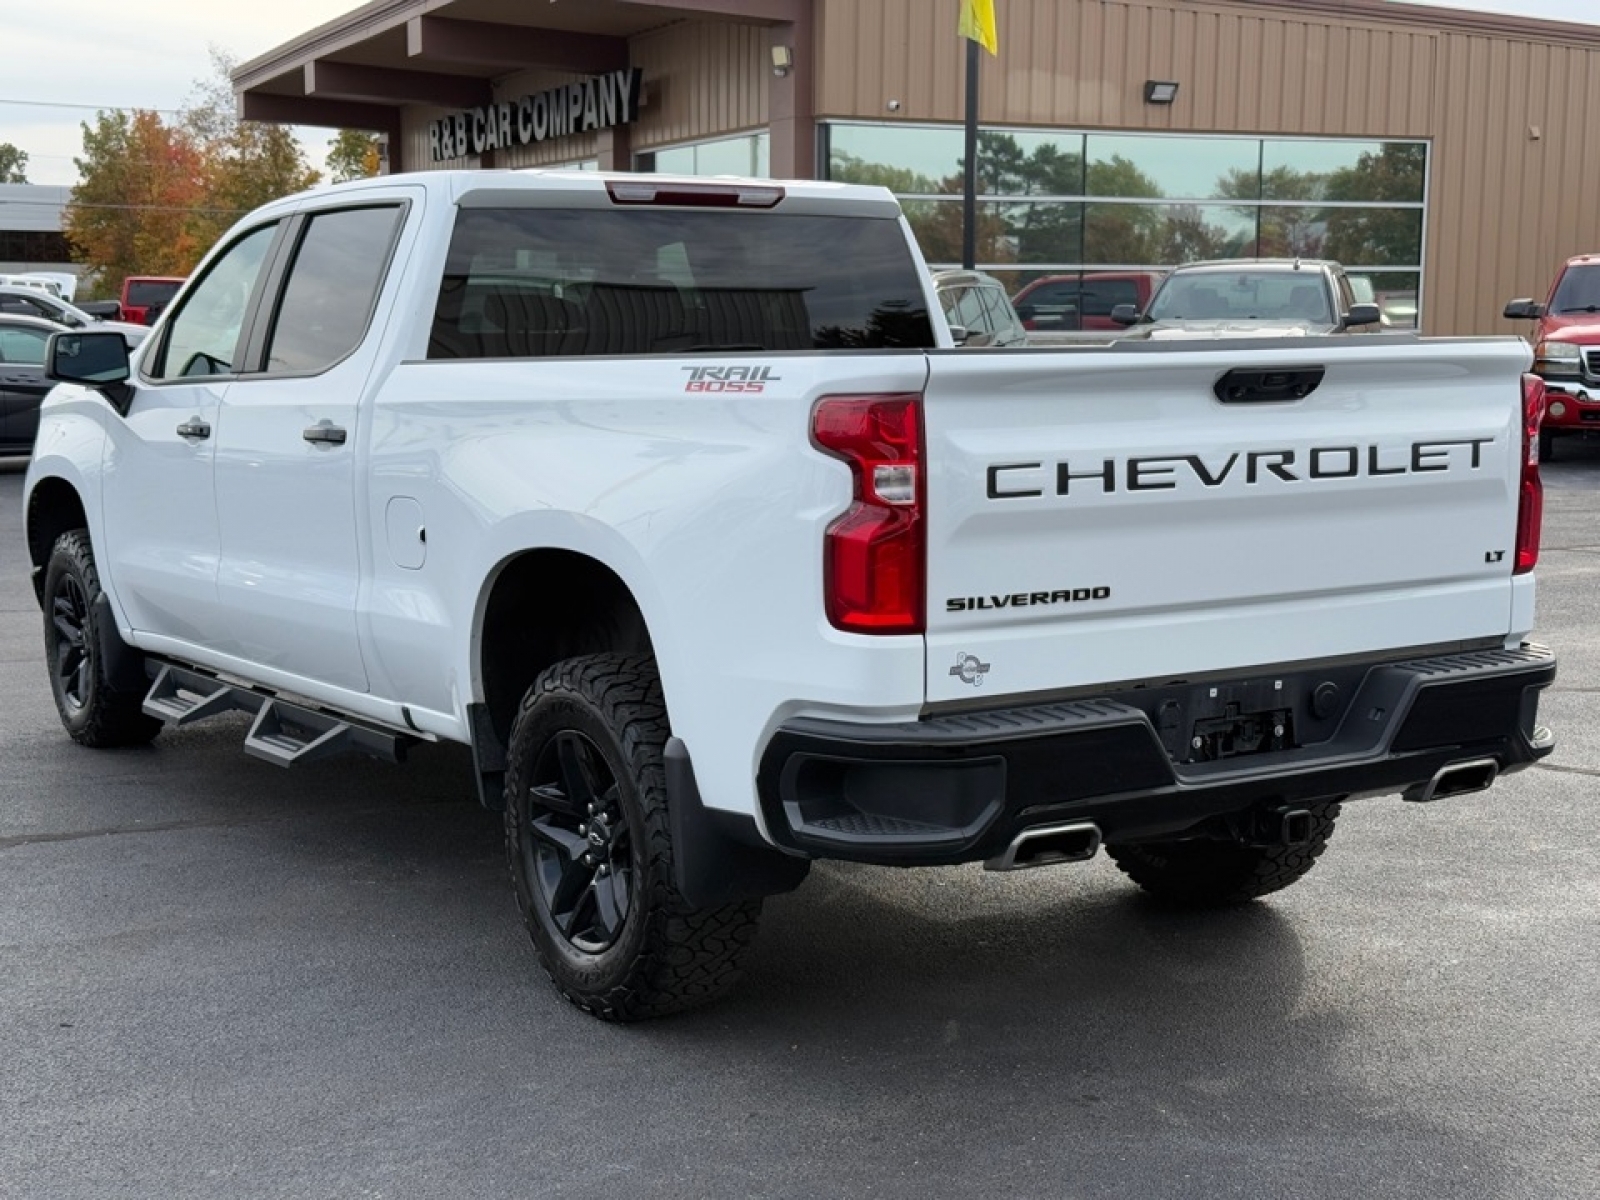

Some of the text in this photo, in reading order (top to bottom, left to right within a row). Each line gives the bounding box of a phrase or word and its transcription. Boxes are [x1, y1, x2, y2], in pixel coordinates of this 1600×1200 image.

[429, 67, 640, 161] R&B CAR COMPANY
[681, 366, 782, 381] TRAIL
[685, 381, 765, 393] BOSS
[986, 437, 1495, 499] CHEVROLET
[1485, 549, 1506, 563] LT
[946, 586, 1111, 612] SILVERADO
